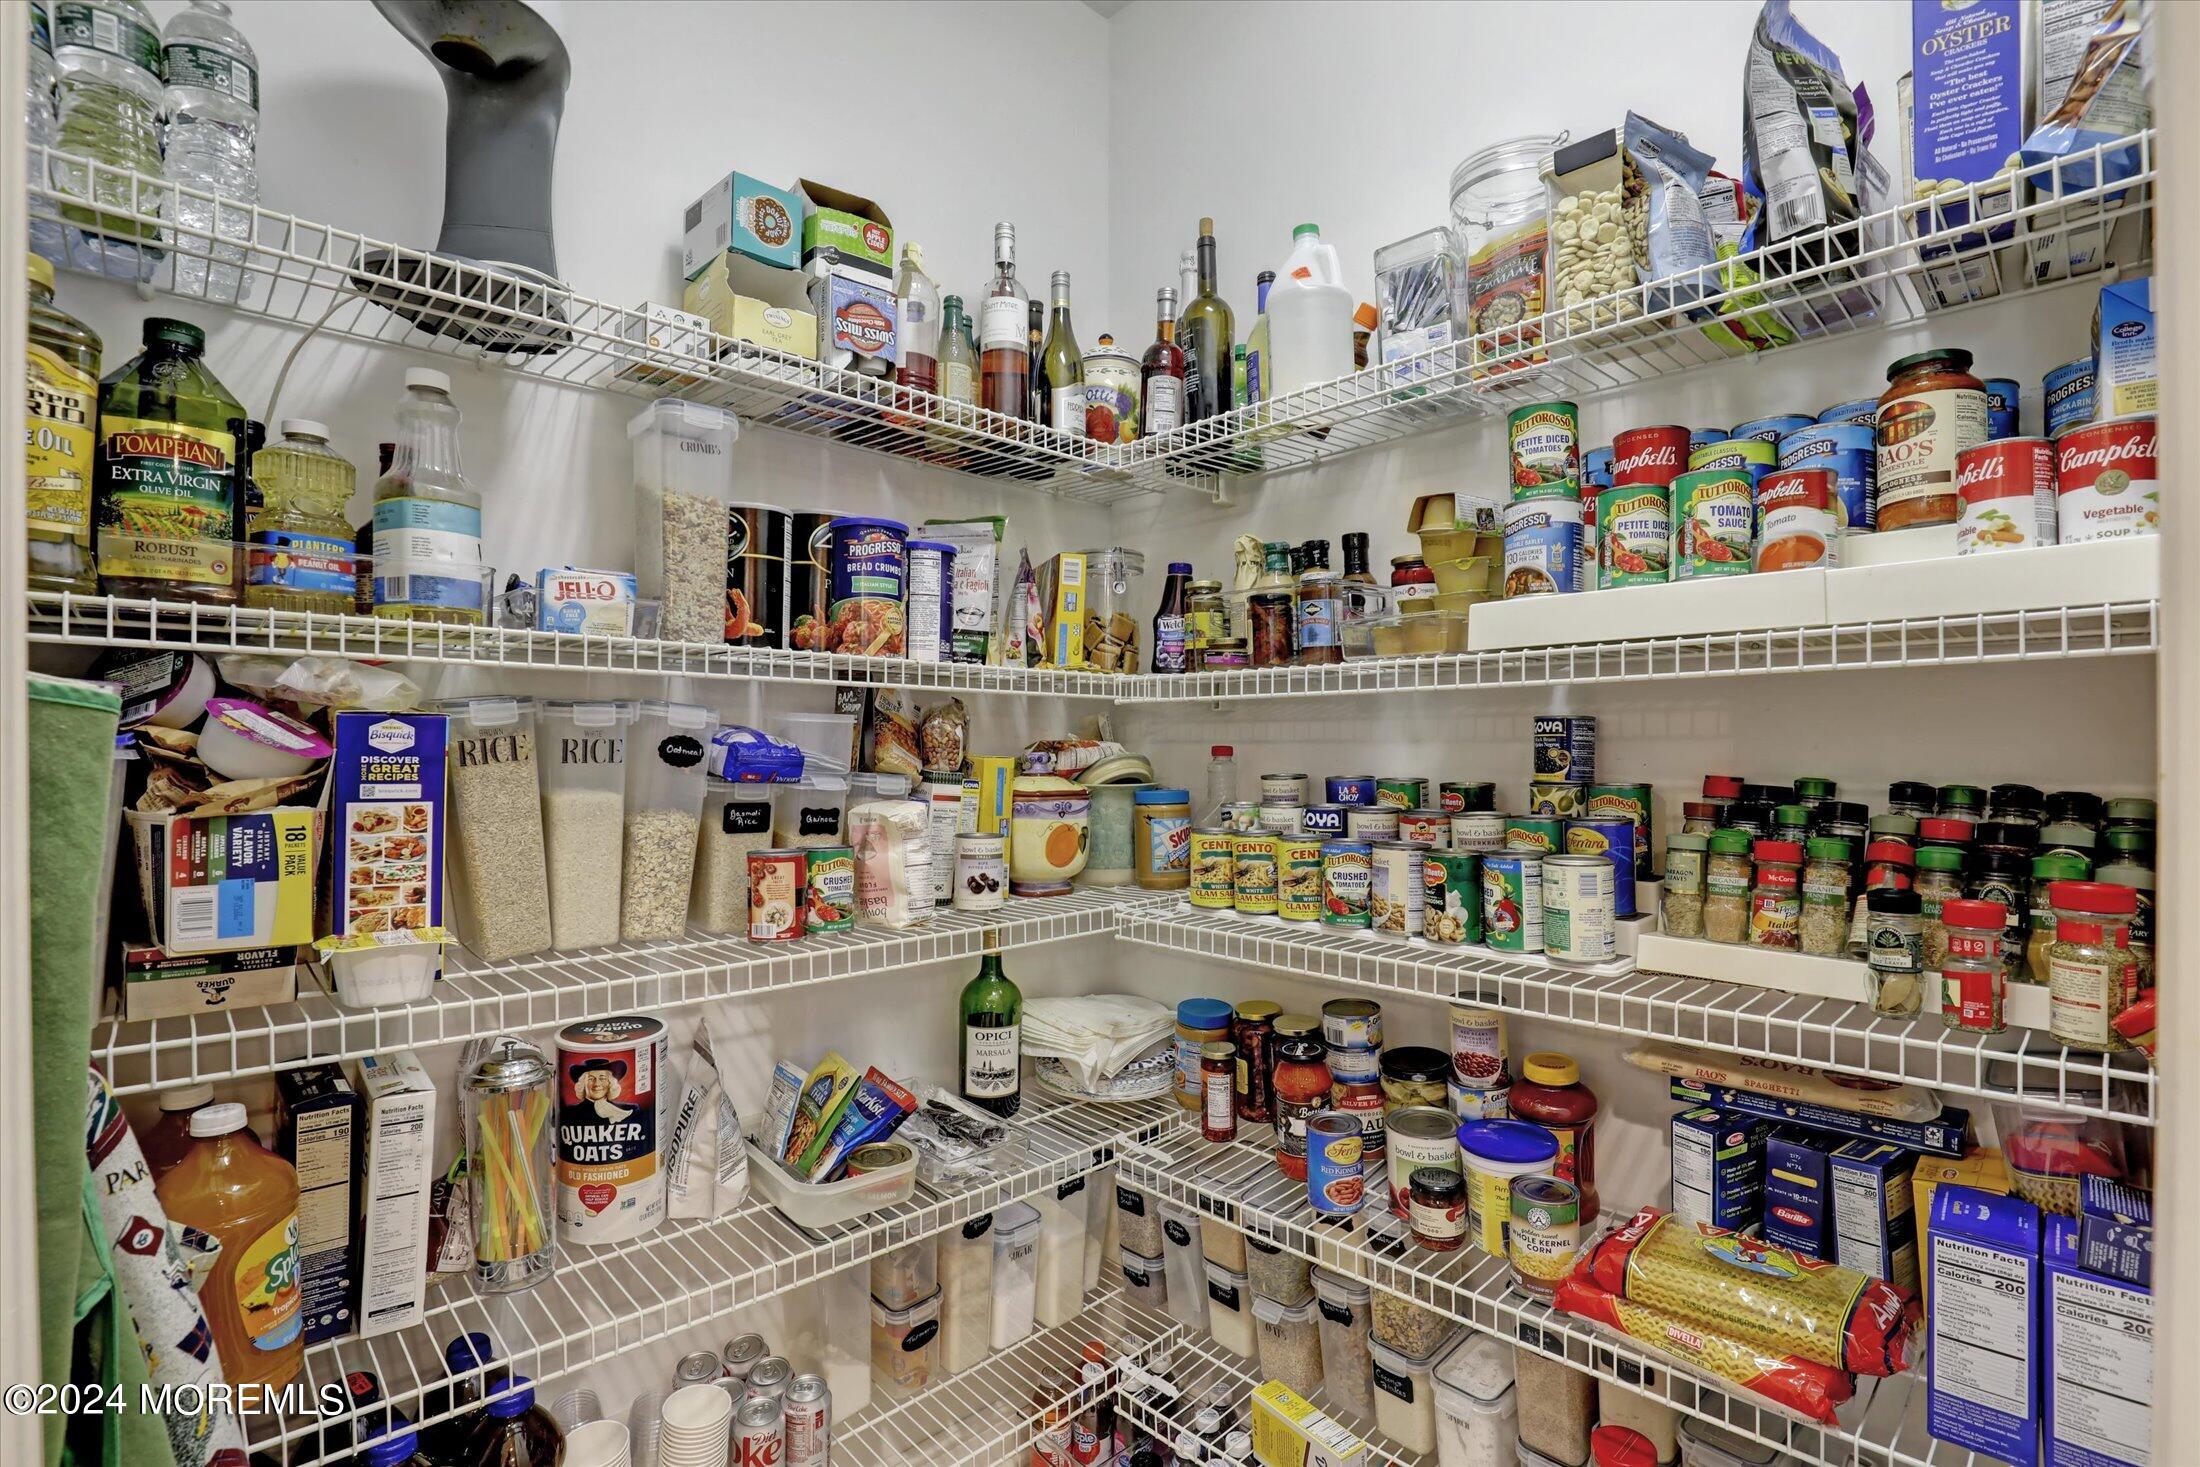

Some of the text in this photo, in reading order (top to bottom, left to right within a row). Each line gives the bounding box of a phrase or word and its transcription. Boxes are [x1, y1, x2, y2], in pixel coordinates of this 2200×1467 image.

[1921, 15, 2011, 56] OYSTER
[1943, 38, 1988, 57] CRACKERS
[1775, 51, 1806, 65] NEW
[1967, 70, 1988, 81] best
[1929, 75, 2003, 101] Oyster Crackers
[1947, 93, 1967, 104] ever
[867, 232, 886, 243] APPLE
[868, 238, 885, 250] CIDER
[762, 328, 792, 341] EARL GREY
[837, 316, 896, 346] SWISS MISS
[2113, 325, 2144, 334] College
[2112, 339, 2133, 347] Broth
[2054, 365, 2092, 382] TRADITIONAL
[1515, 413, 1571, 434] TUTTOROSSO
[2080, 424, 2143, 440] CONDENSED
[37, 427, 75, 457] OIL
[1516, 434, 1570, 450] PETITE DICED
[116, 436, 218, 465] POMPEIAN
[1525, 444, 1562, 456] TOMATOES
[1780, 440, 1832, 470] PROGRESSO
[1877, 438, 1934, 471] RAO'S
[111, 466, 222, 492] EXTRA VIRGIN
[1880, 475, 1924, 492] BOLOGNESE
[139, 484, 194, 499] OLIVE OIL
[1710, 504, 1751, 518] TOMATO
[2083, 504, 2144, 520] Vegetable
[1618, 520, 1649, 531] PETITE
[1718, 517, 1748, 529] SAUCE
[1766, 513, 1797, 531] Tomato
[1629, 531, 1666, 540] TOMATOES
[2096, 528, 2131, 540] SOUP
[134, 541, 199, 557] ROBUST
[850, 541, 901, 557] PROGRESSO
[1519, 549, 1543, 557] CALORIES
[298, 559, 327, 569] PEANUT
[847, 562, 902, 576] BREAD CRUMBS
[880, 582, 893, 590] STYLE
[370, 729, 414, 741] Bisquick
[457, 734, 529, 767] RICE
[561, 738, 623, 764] RICE
[666, 743, 703, 757] Oatmeal
[361, 756, 420, 764] DISCOVER
[370, 764, 420, 773] GREAT
[368, 773, 419, 781] RECIPES
[1338, 785, 1348, 793] LA
[1338, 792, 1359, 802] CHOY
[737, 817, 759, 827] Rice
[1457, 829, 1472, 837] bowl
[232, 827, 242, 868] VARIETY
[243, 829, 254, 865] FLAVOR
[1236, 843, 1272, 854] CENTO
[1567, 832, 1606, 851] Ferrara
[285, 825, 307, 877] 18 VALUE PACK
[1332, 871, 1368, 881] CRUSHED
[1427, 868, 1445, 877] Monte
[1668, 875, 1688, 883] LEAVES
[1709, 877, 1741, 885] ORGANIC
[1195, 889, 1218, 897] CLAM
[1709, 886, 1742, 895] CORIANDER
[1807, 892, 1830, 901] FENNEL
[197, 977, 235, 989] QUAKER
[1451, 1017, 1465, 1027] bowl
[1474, 1018, 1500, 1028] basket
[975, 1031, 1012, 1041] OPICI
[976, 1048, 1012, 1057] MARSALA
[1695, 1068, 1800, 1096] RAO'S SPAGHETTI
[810, 1088, 827, 1107] THAI
[299, 1107, 350, 1122] Nutrition Facts
[381, 1106, 407, 1115] Nutrition
[298, 1127, 350, 1144] Calories 190
[380, 1122, 424, 1136] Calories 200
[668, 1089, 699, 1178] ISOPURE
[573, 1144, 624, 1163] OATS
[1395, 1144, 1426, 1160] bowl &
[568, 1168, 630, 1180] OLD FASHIONED
[1335, 1164, 1359, 1175] KIDNEY
[1834, 1165, 1876, 1182] Nutrition Facts
[1834, 1182, 1878, 1198] Calories 200
[1777, 1208, 1810, 1225] Barilla
[1512, 1229, 1572, 1249] WHOLE KERNEL
[1520, 1227, 1559, 1241] golden sweet
[1008, 1243, 1034, 1262] SUGAR
[1526, 1243, 1553, 1254] CORN
[1937, 1238, 2026, 1268] Nutrition Facts
[1937, 1267, 2026, 1296] Calories 200
[2056, 1275, 2116, 1297] Nutrition
[2056, 1304, 2109, 1327] Calories
[1667, 1325, 1703, 1350] DIVELLA
[752, 1430, 777, 1446] Diet
